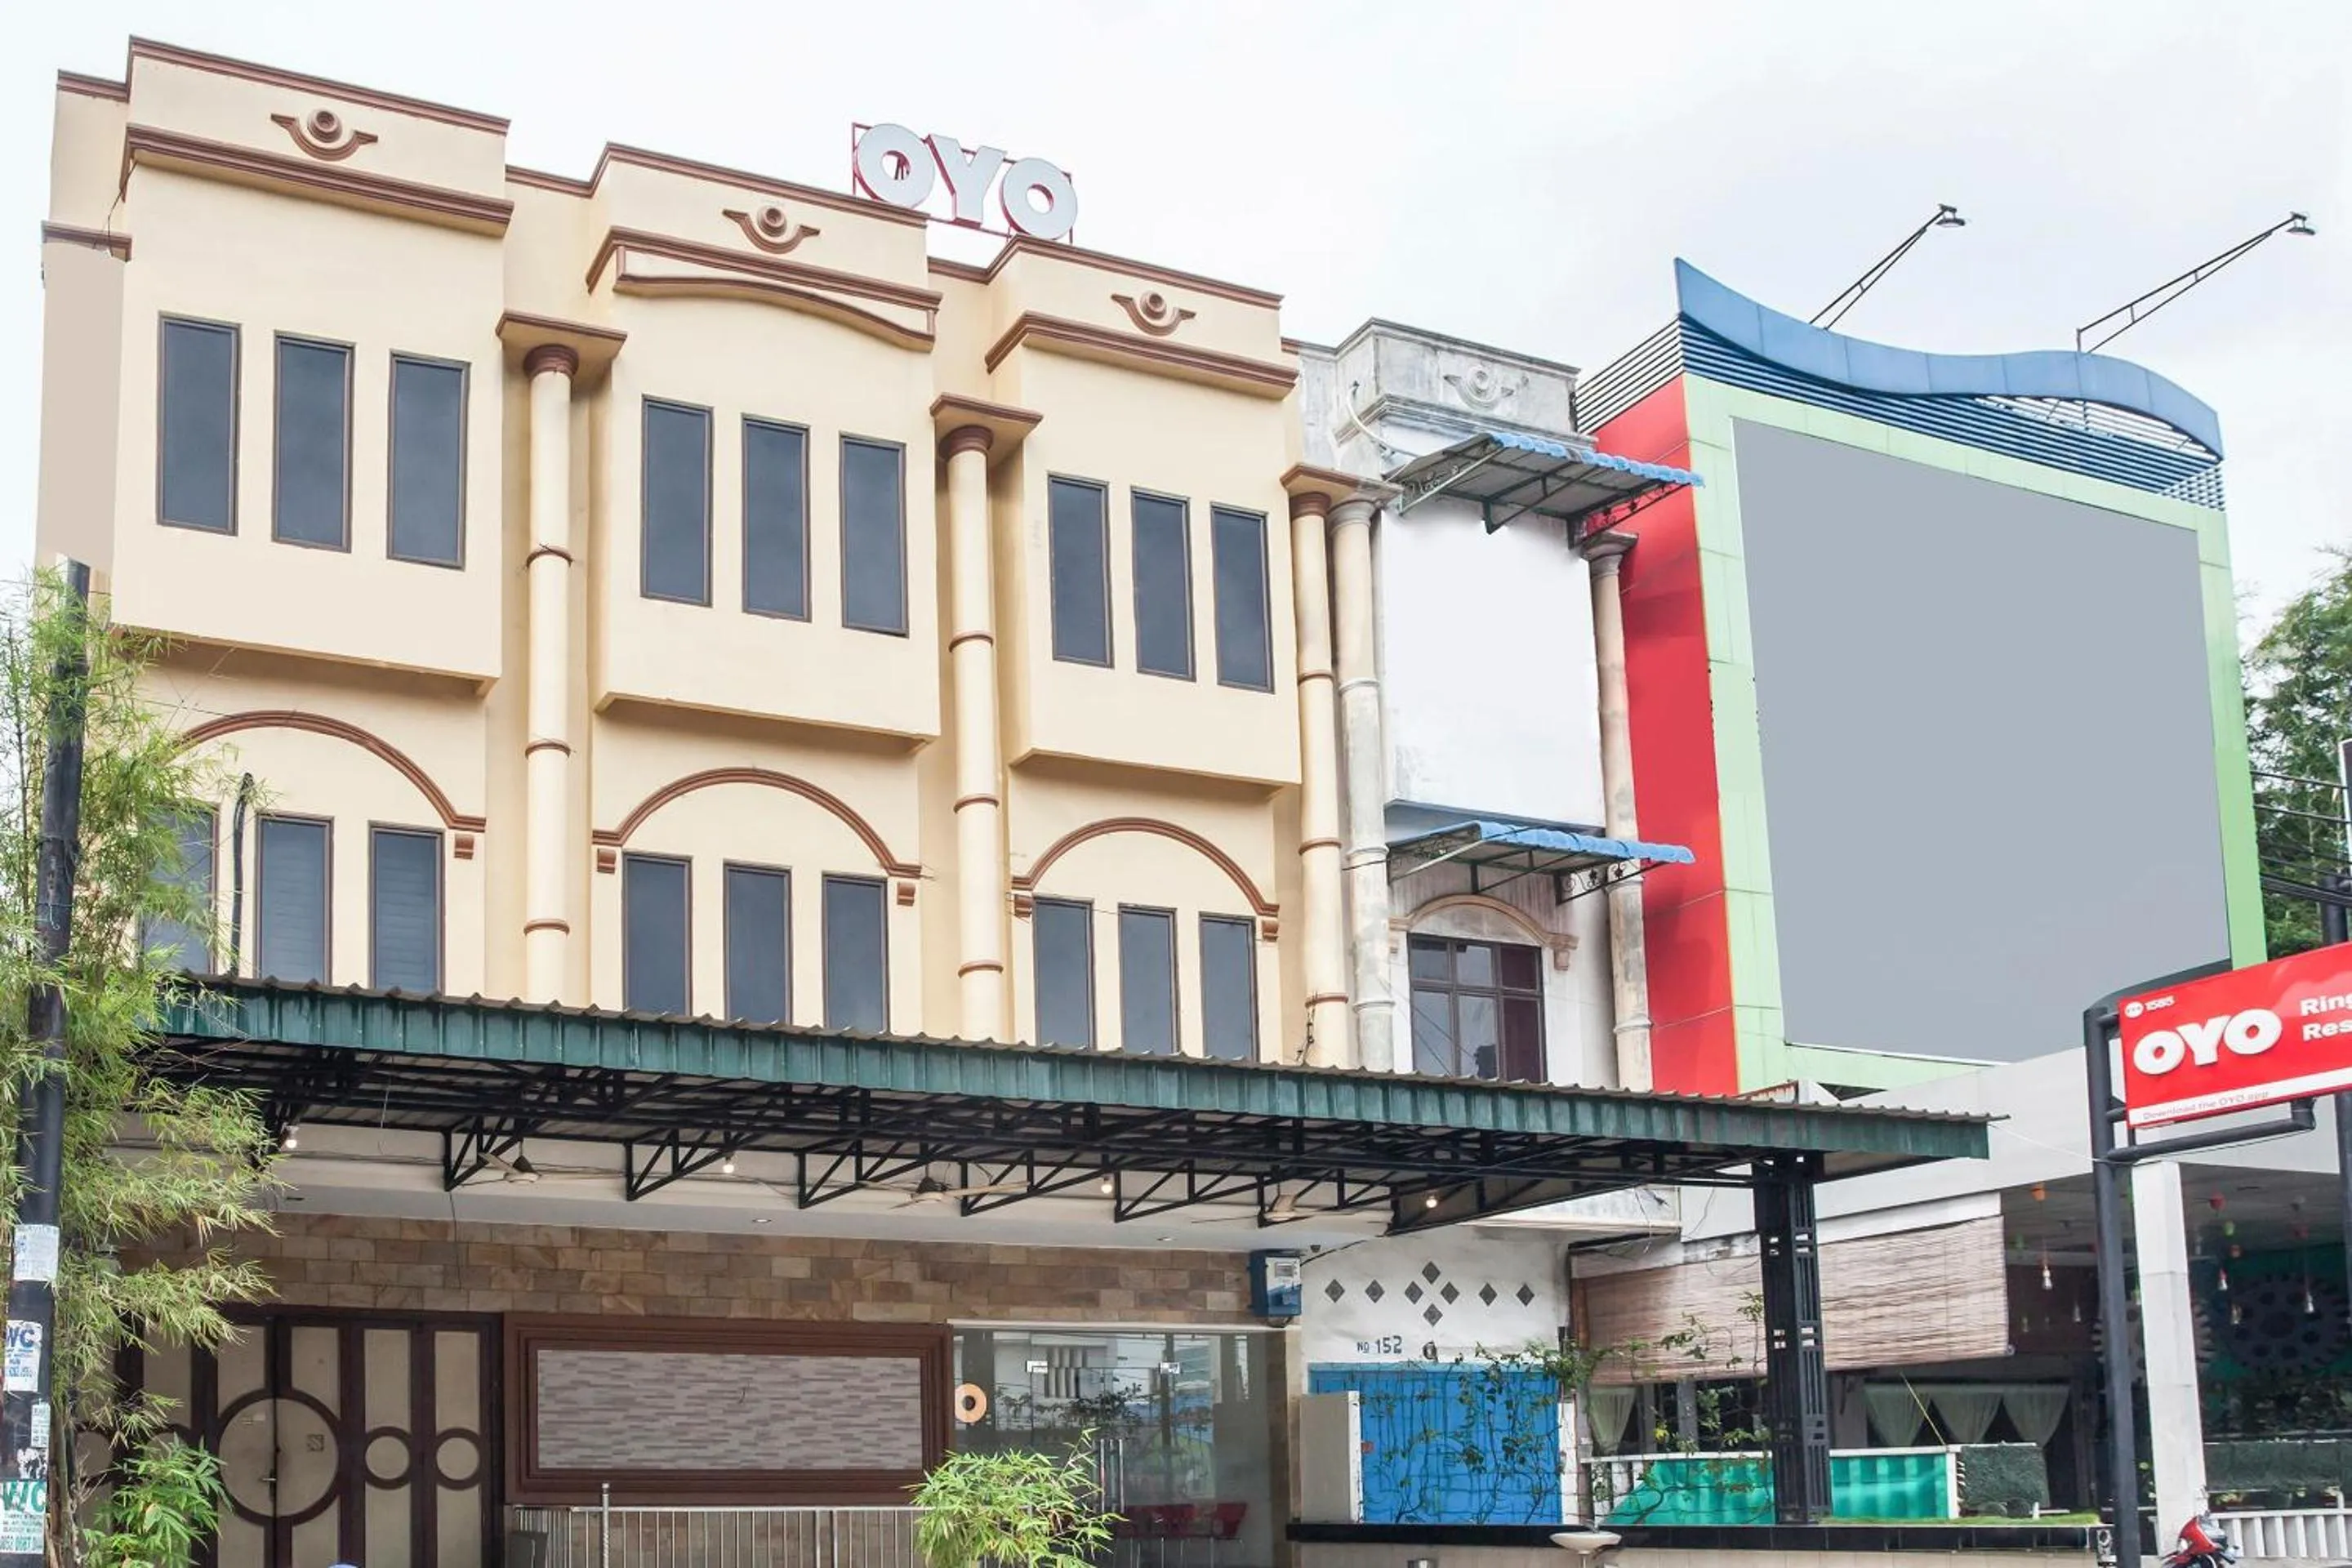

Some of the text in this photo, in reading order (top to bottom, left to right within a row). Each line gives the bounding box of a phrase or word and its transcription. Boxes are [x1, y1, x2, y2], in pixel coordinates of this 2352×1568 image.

[854, 123, 1078, 240] OYO
[2133, 1009, 2283, 1076] OYO
[2219, 1094, 2244, 1107] OYO
[1375, 1335, 1402, 1354] 152
[2, 1479, 47, 1512] WC
